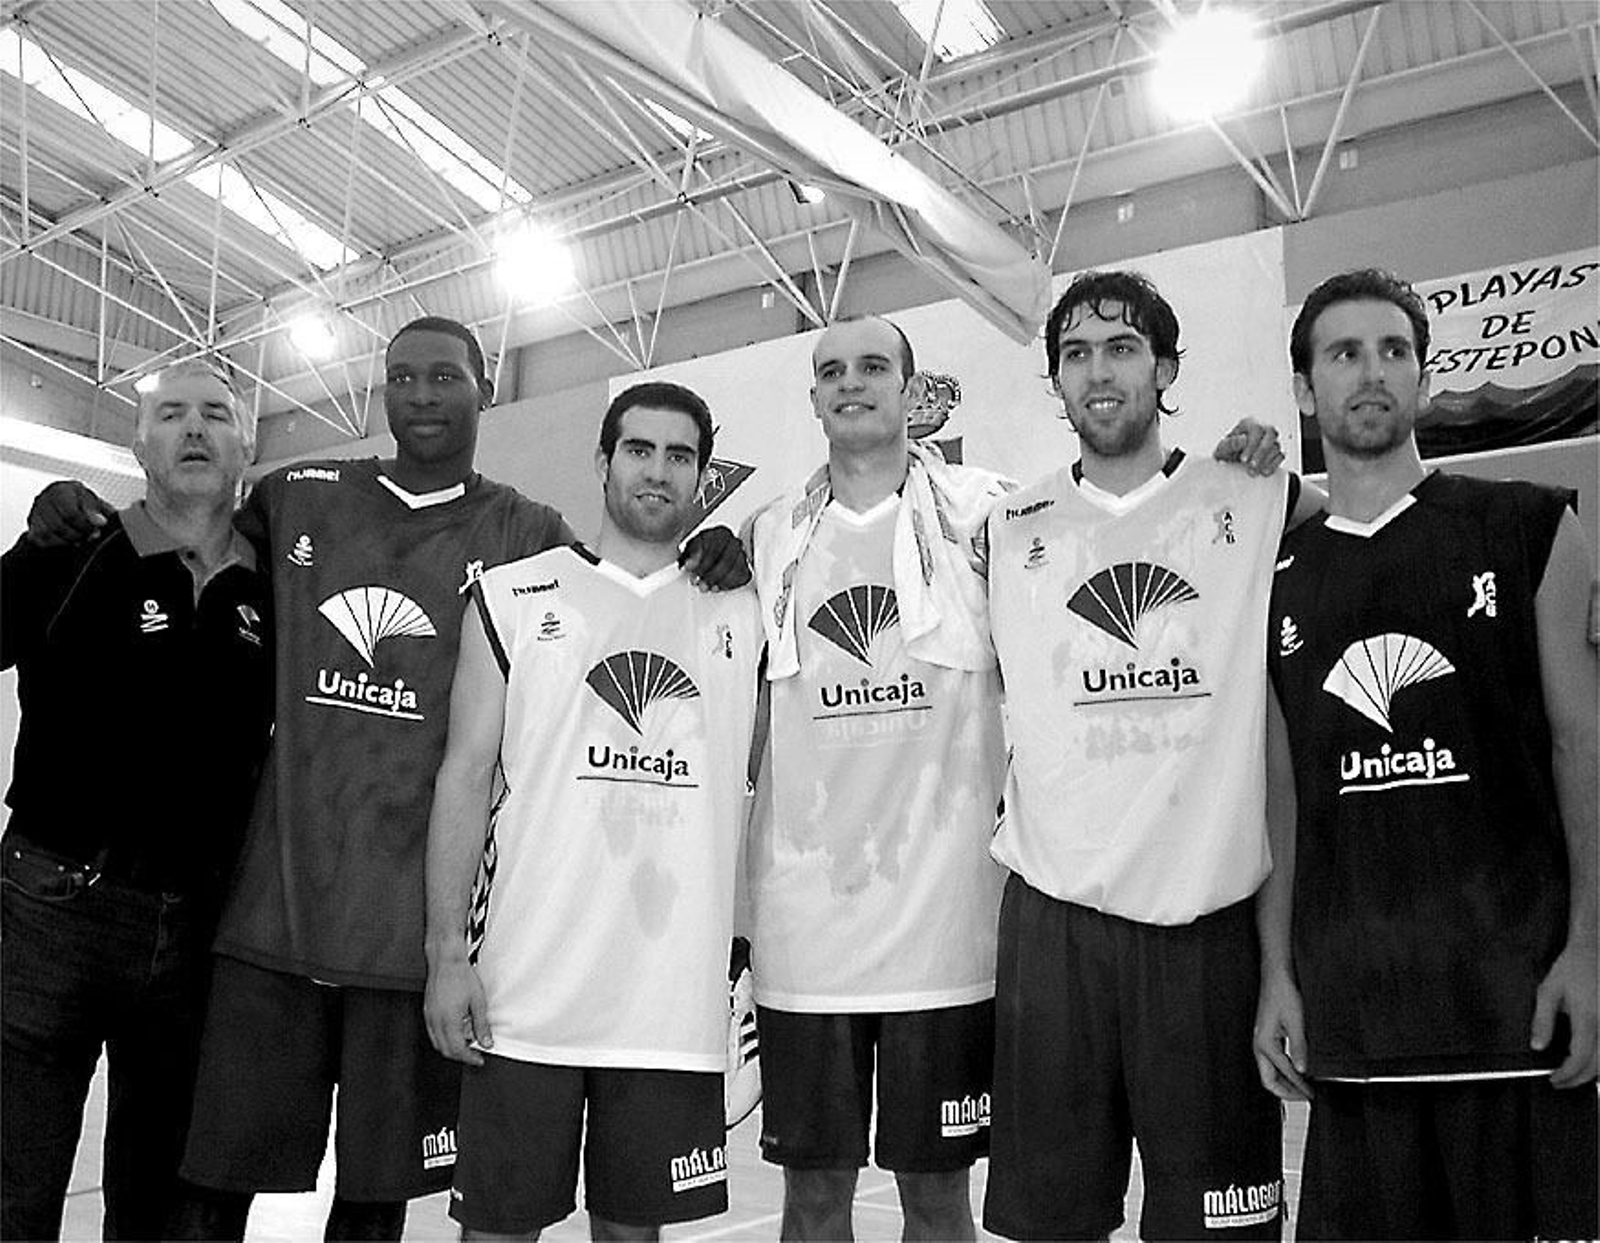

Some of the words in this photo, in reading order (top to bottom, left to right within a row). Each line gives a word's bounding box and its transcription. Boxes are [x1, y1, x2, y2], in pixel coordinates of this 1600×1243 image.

[1427, 262, 1599, 315] PLAYAS
[1481, 310, 1535, 339] DE
[1424, 321, 1600, 374] ESTEPON
[317, 669, 417, 712] Unicaja
[820, 673, 925, 708] Unicaja
[1082, 657, 1200, 693] Unicaja
[588, 746, 689, 781] Unicaja
[1340, 737, 1456, 780] Unicaja
[941, 1092, 991, 1125] MÁLA
[422, 1126, 458, 1157] MÁL
[671, 1147, 728, 1181] MÁLA
